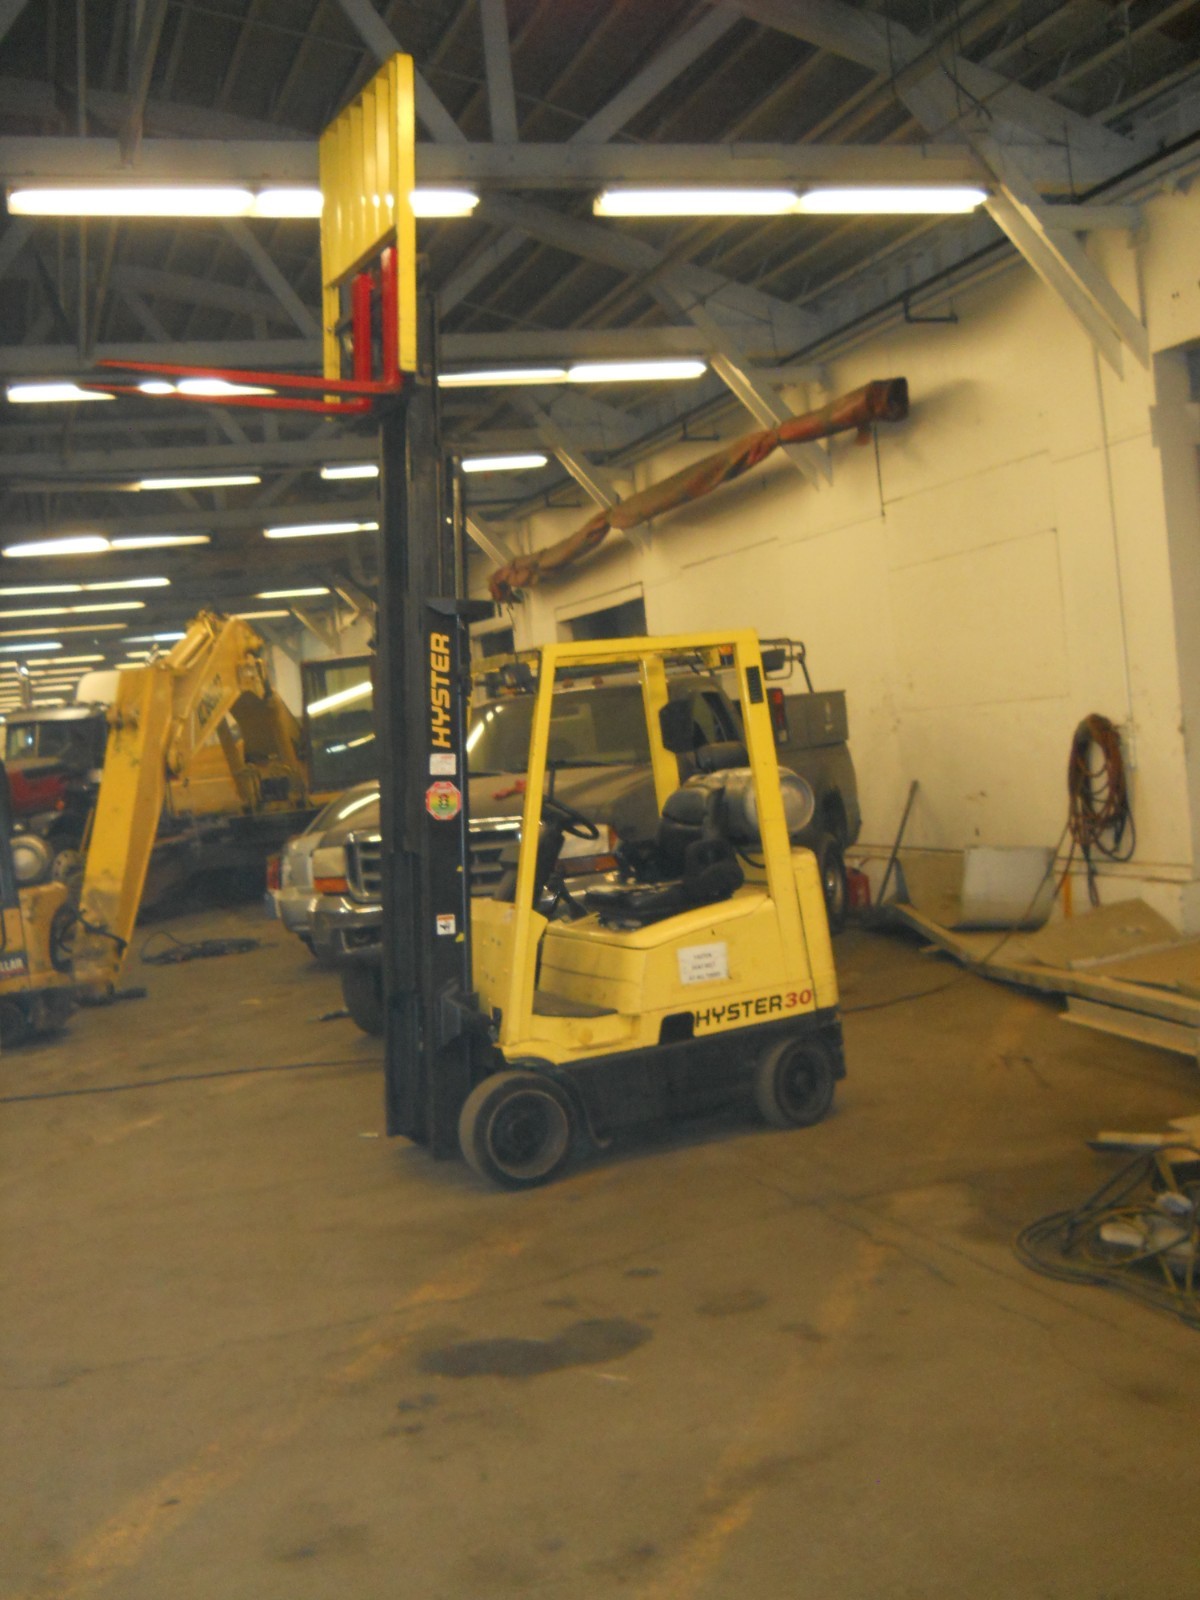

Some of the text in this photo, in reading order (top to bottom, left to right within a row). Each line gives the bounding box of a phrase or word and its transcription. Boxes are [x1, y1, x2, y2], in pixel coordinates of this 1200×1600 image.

[430, 631, 452, 748] HYSTER
[695, 988, 812, 1027] HYSTER 30
